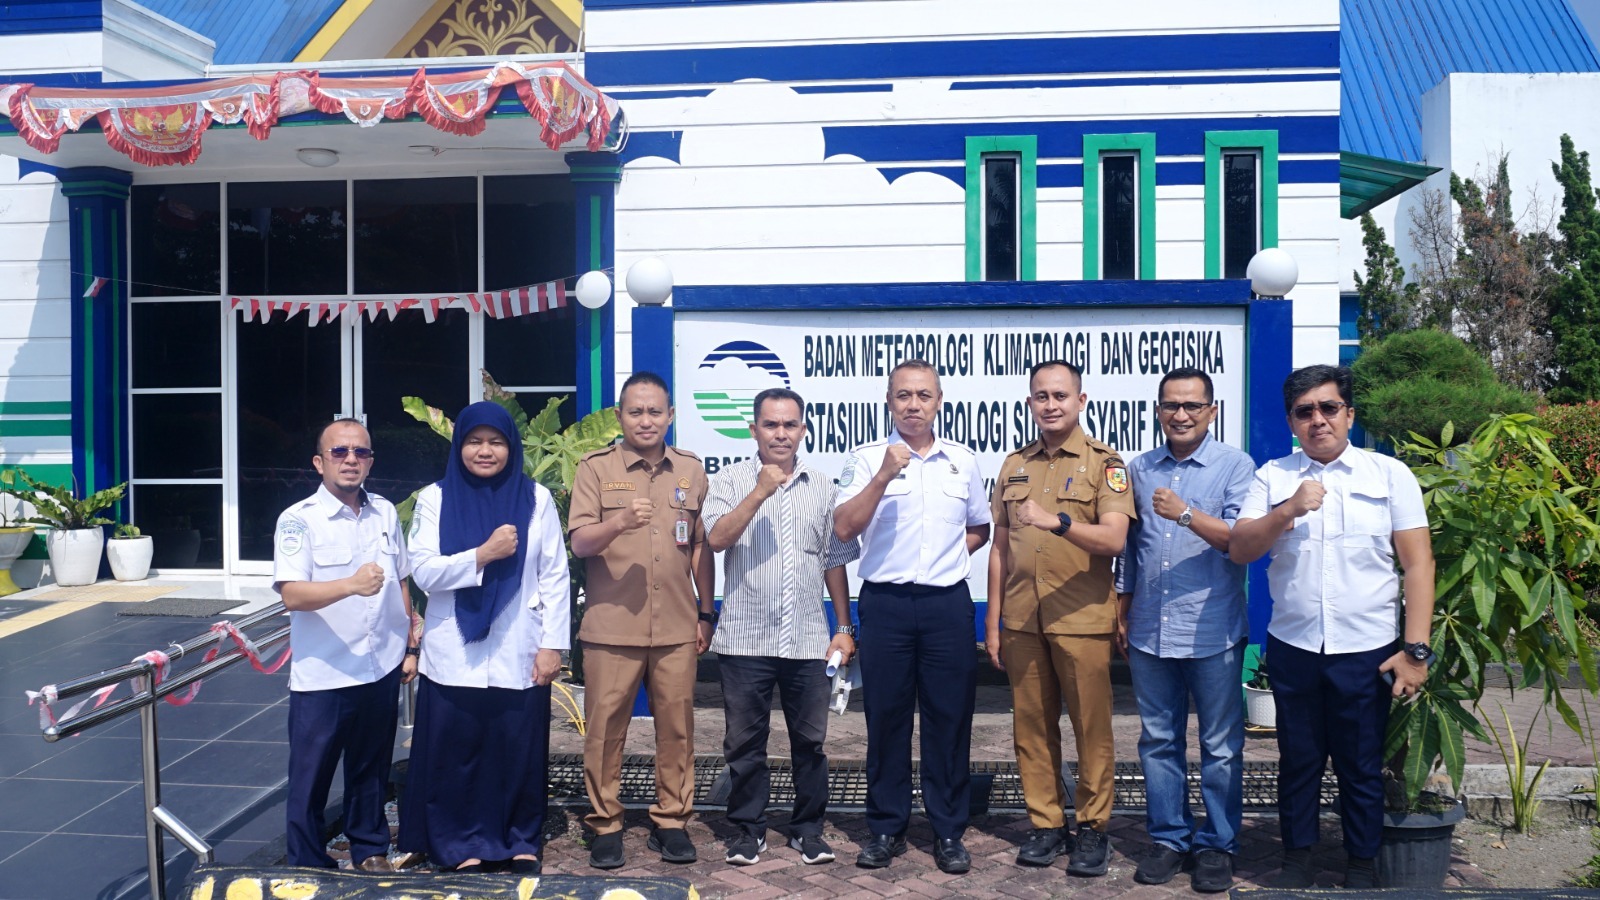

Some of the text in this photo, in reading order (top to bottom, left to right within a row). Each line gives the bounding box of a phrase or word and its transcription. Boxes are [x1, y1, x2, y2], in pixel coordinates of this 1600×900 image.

[804, 330, 1225, 378] BADAN METEOROLOGI KLIMATOLOGI DAN GEOFISIKA
[804, 402, 878, 454] STASIUN
[884, 400, 1007, 454] MROLOGI
[1086, 400, 1147, 452] SYARIF
